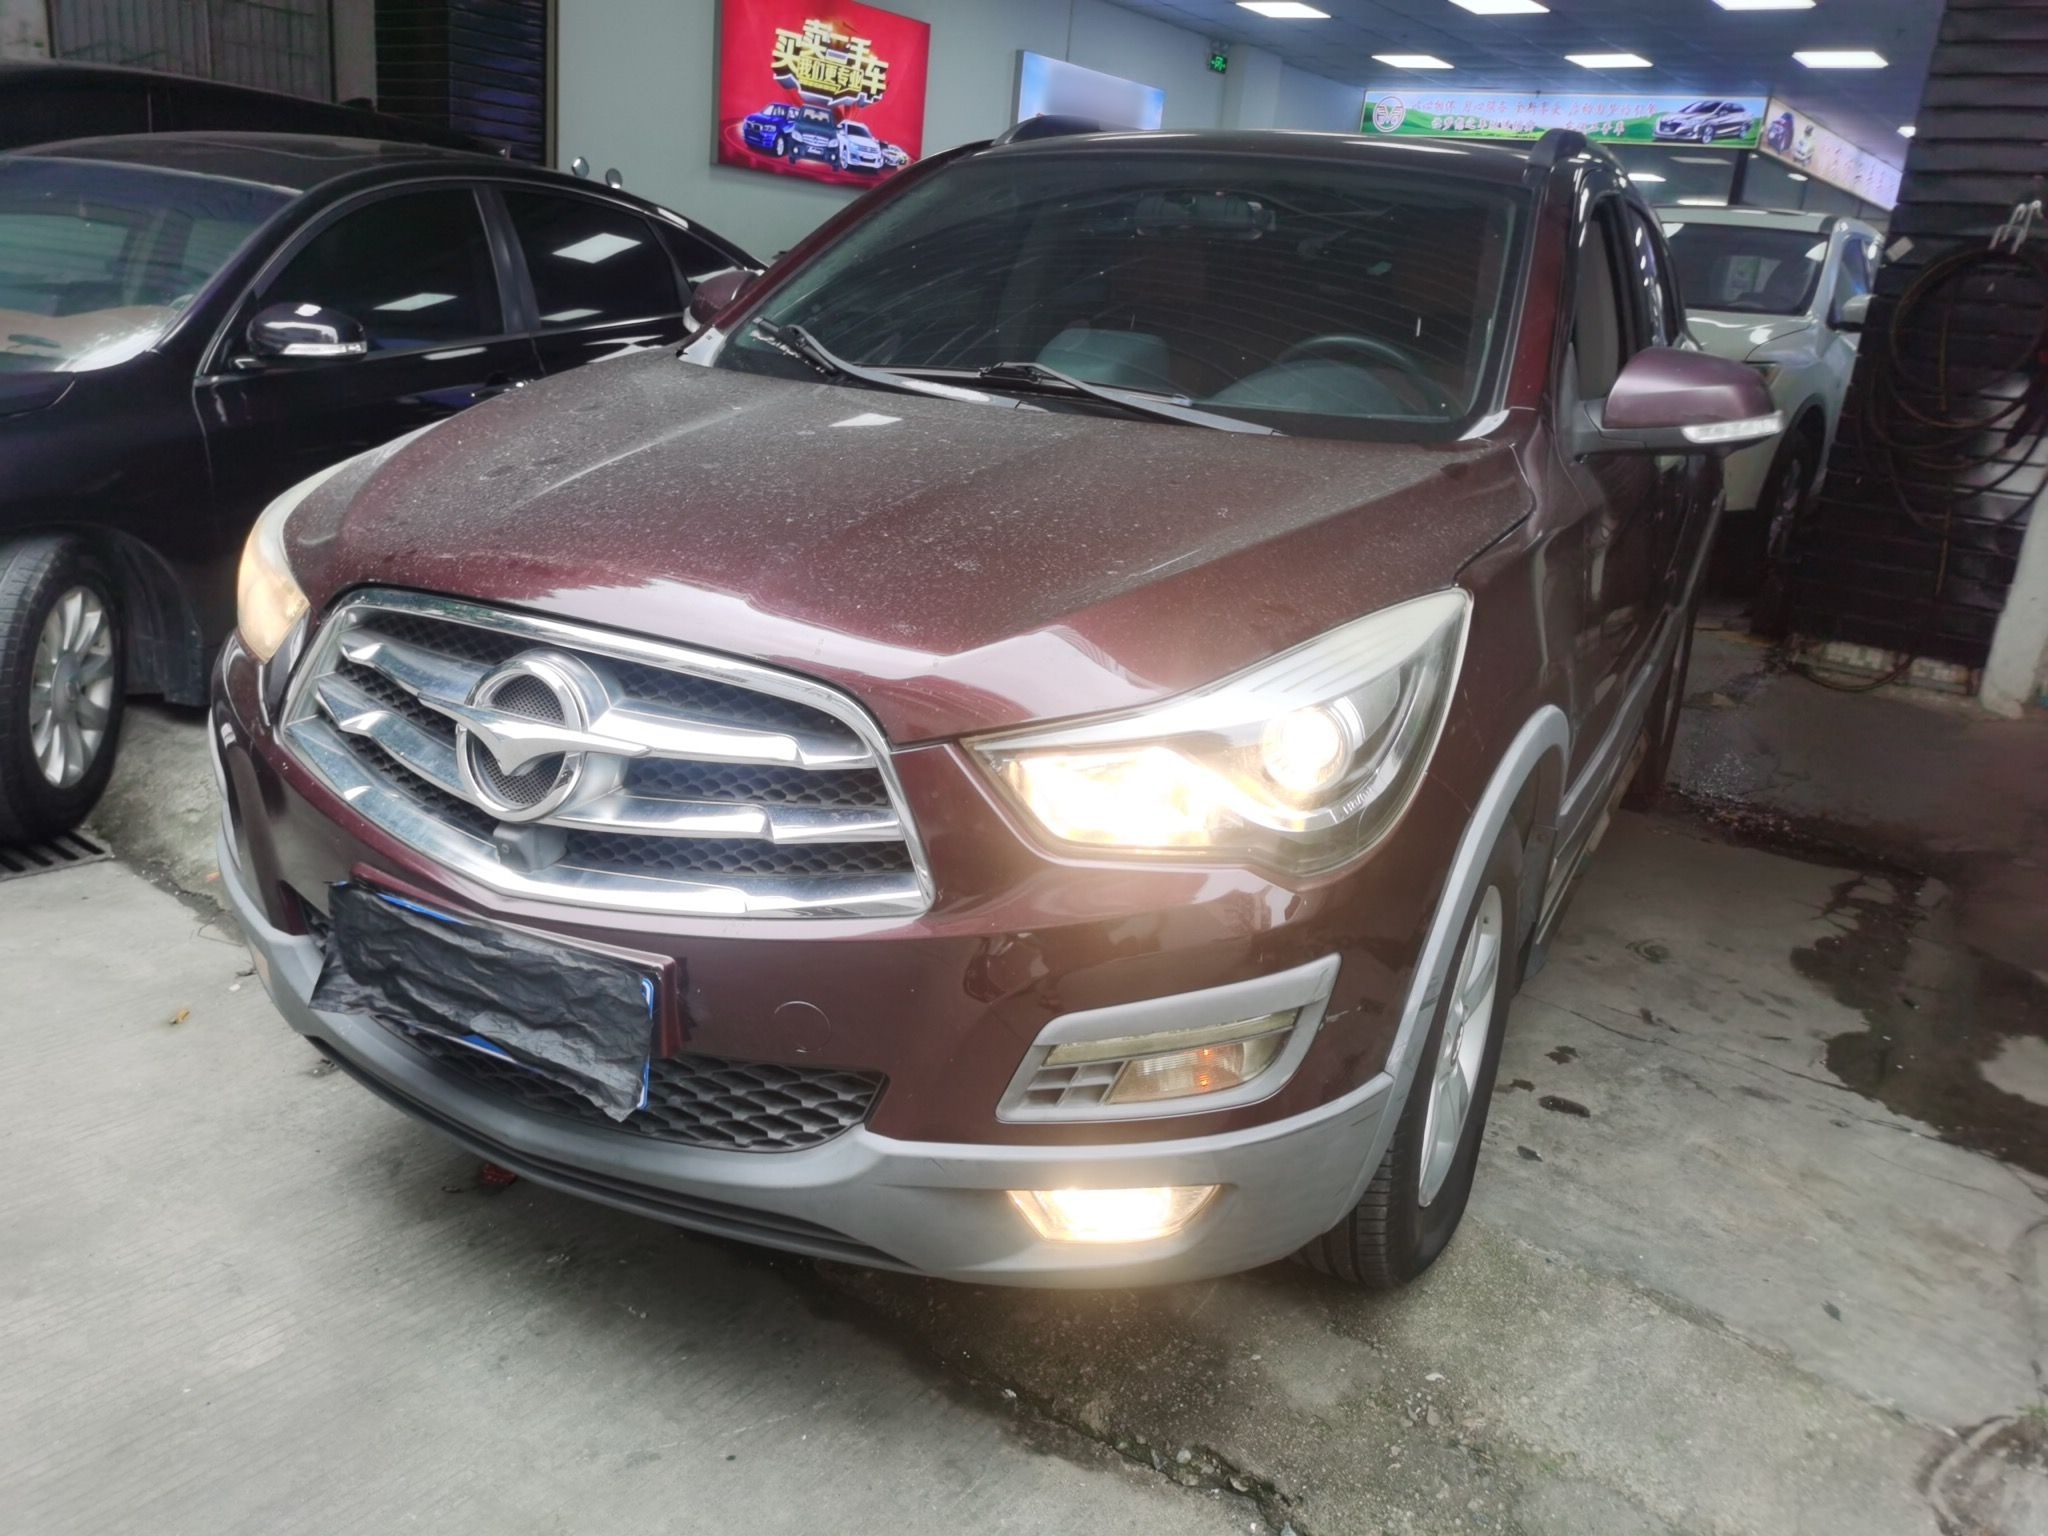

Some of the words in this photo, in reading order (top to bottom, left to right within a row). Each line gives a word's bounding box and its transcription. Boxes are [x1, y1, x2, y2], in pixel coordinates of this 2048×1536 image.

[771, 19, 889, 95] 买卖二手车
[797, 57, 864, 91] 我们更专业
